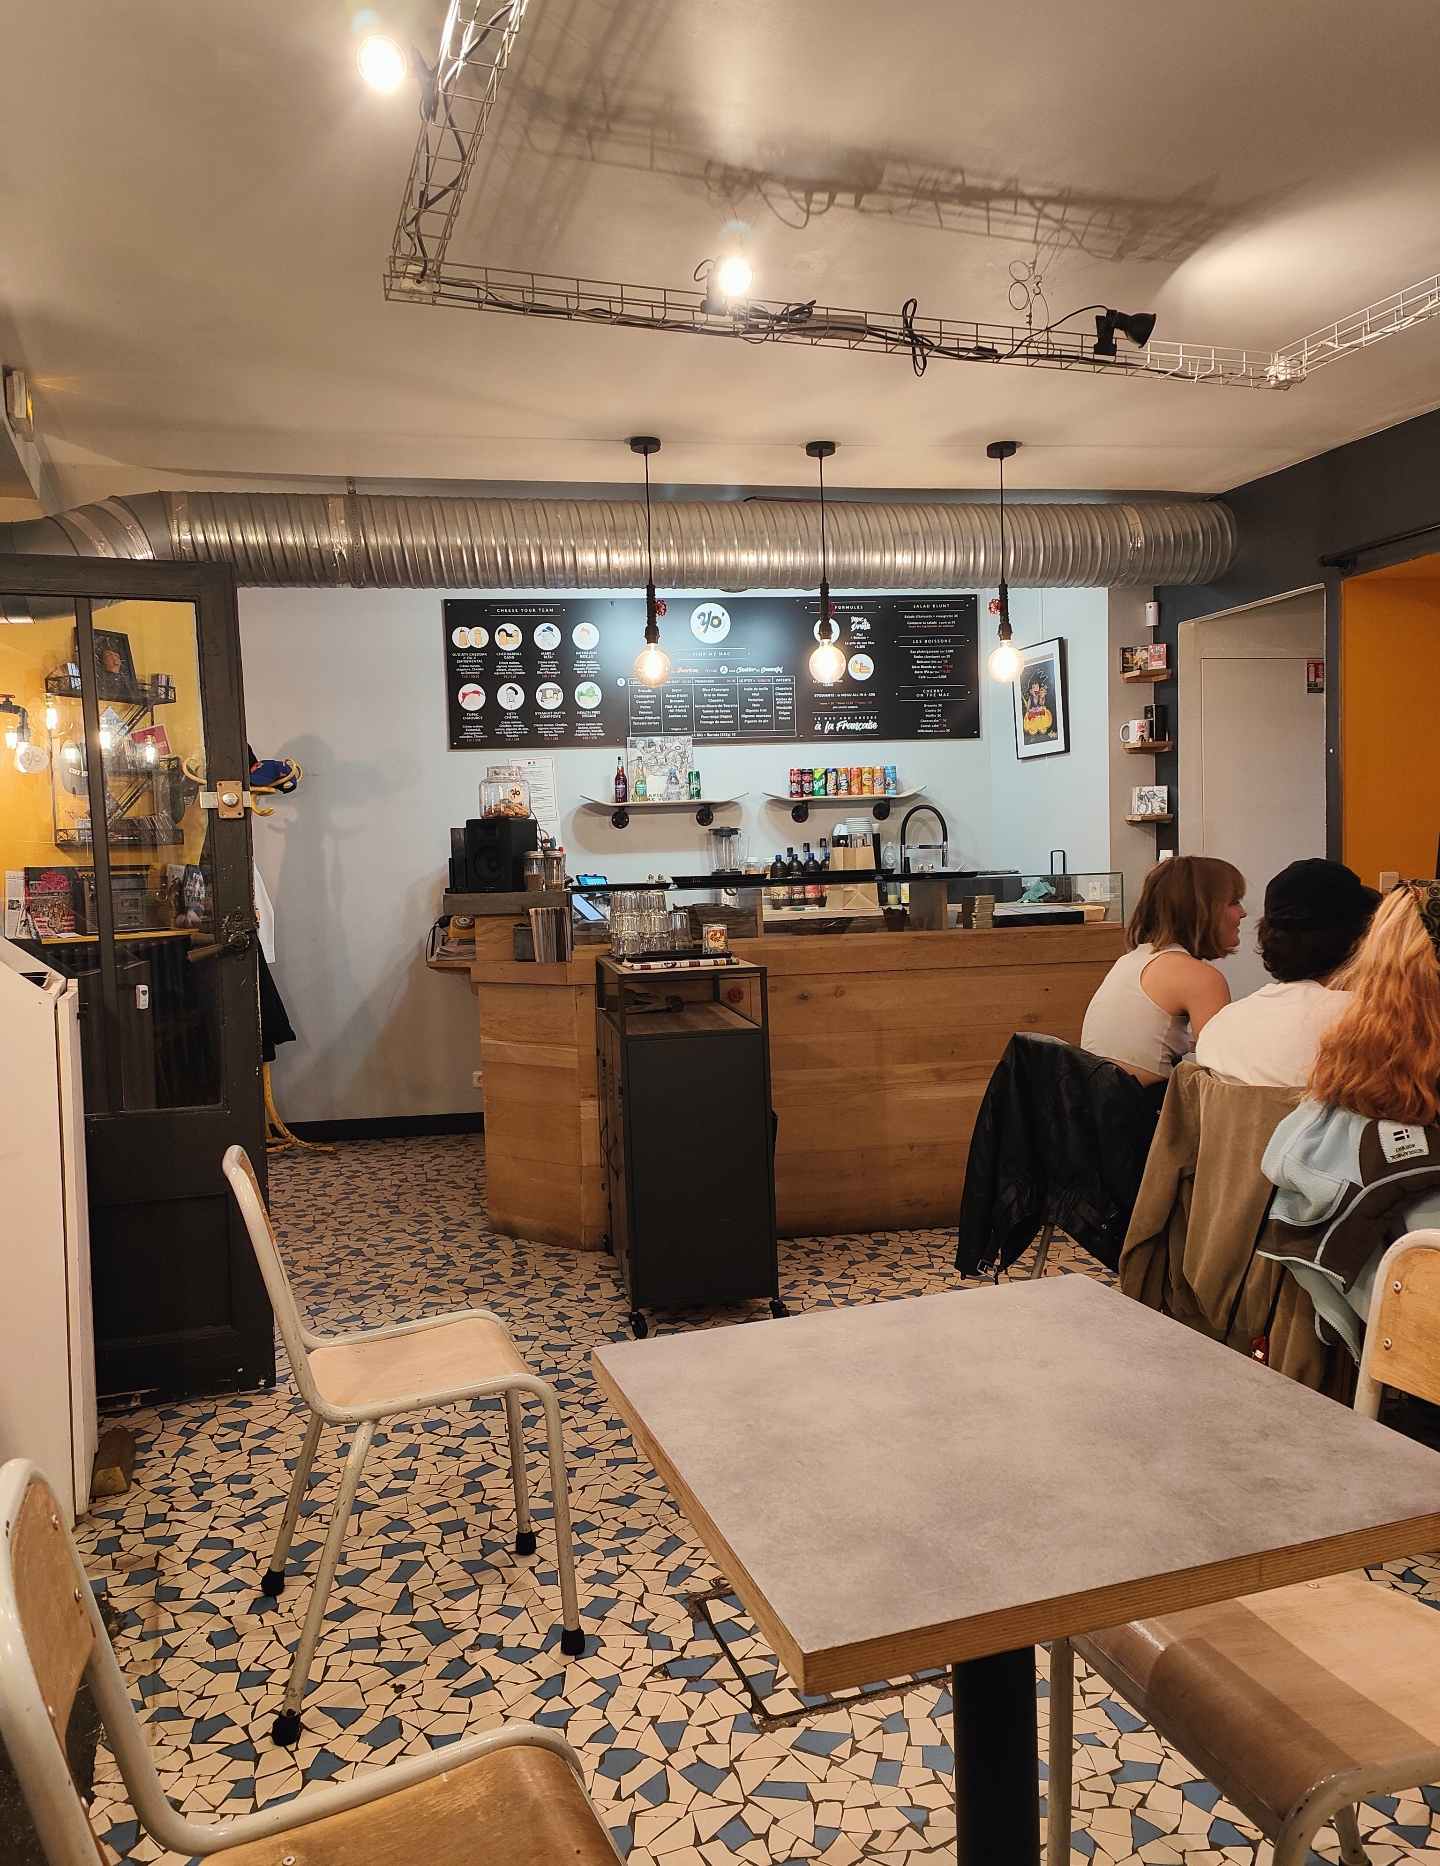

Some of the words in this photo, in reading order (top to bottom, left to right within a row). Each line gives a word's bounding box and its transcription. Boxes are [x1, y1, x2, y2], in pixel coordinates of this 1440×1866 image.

[814, 721, 821, 730] à
[824, 720, 834, 734] la
[836, 720, 878, 732] Française
[1395, 1144, 1416, 1153] NORWAY
